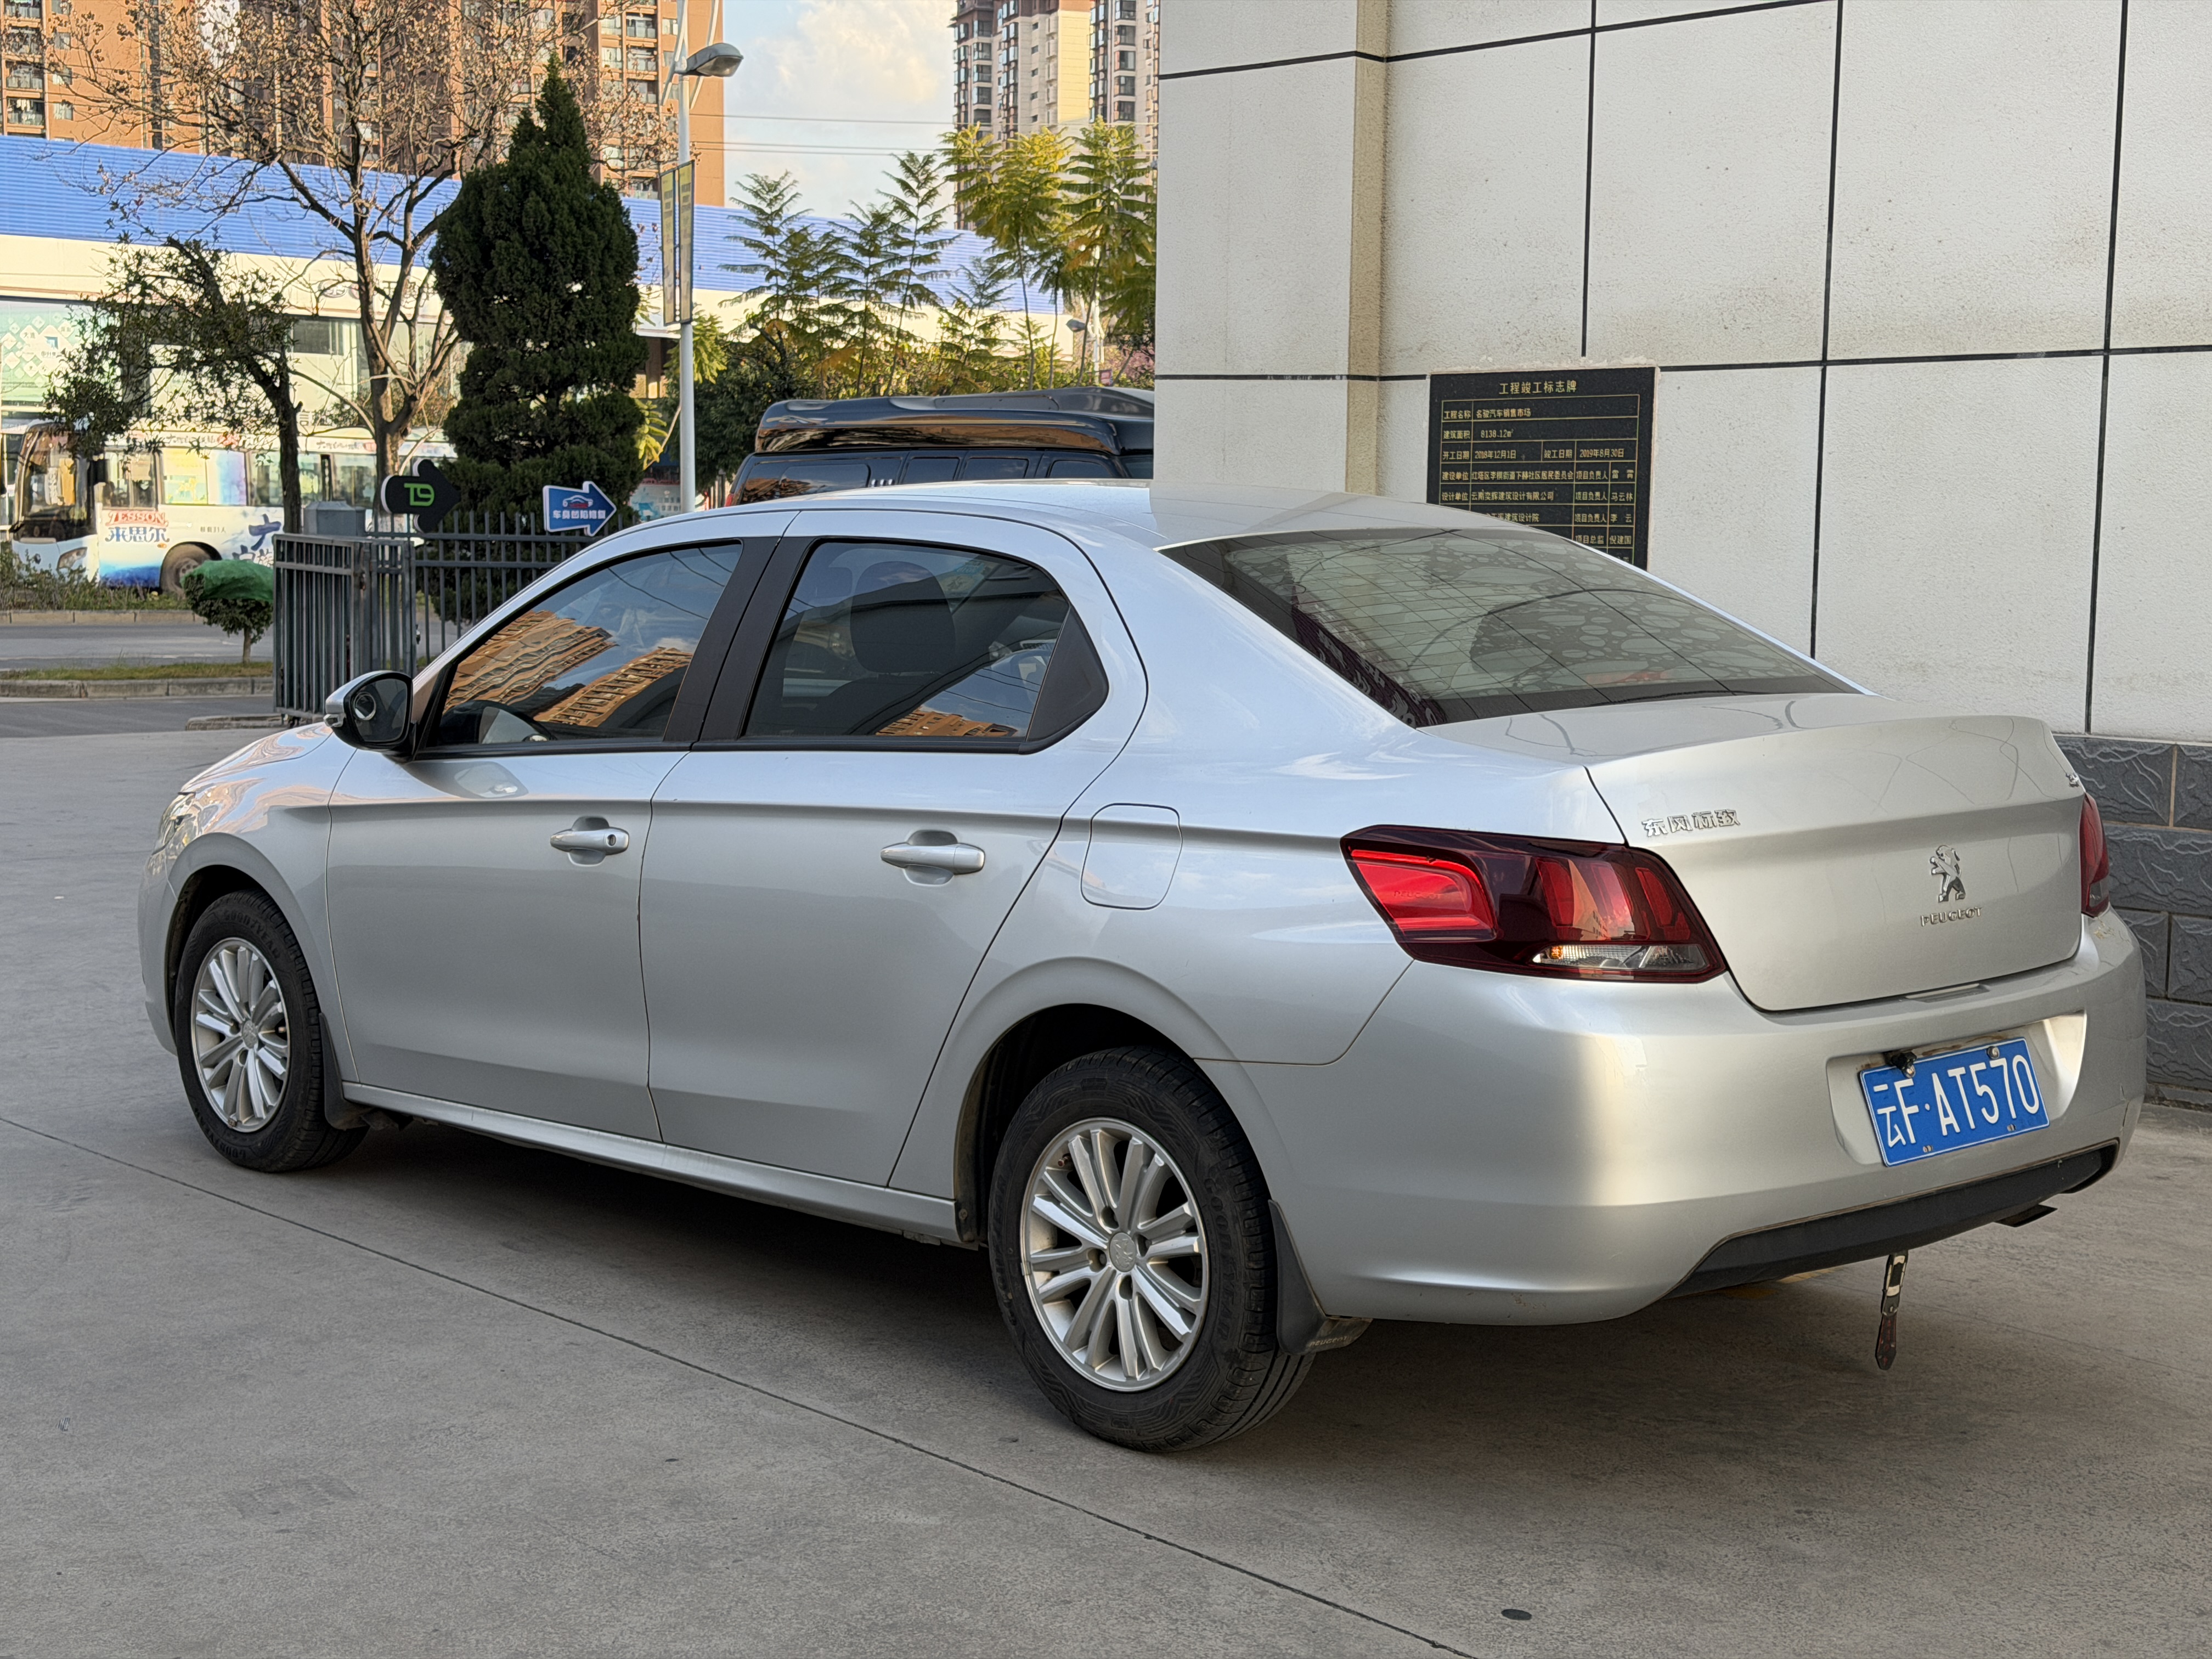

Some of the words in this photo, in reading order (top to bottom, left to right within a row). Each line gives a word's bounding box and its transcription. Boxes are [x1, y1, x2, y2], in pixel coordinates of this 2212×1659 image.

[1499, 380, 1577, 394] 工程竣工标志牌
[1443, 410, 1471, 419] 工程名称
[1443, 430, 1470, 439] 建筑面积
[1442, 450, 1470, 460] 开工日期
[1474, 450, 1516, 459] 2018年12月1日
[1544, 449, 1573, 459] 竣工日期
[1579, 448, 1624, 458] 2019年8月30日
[1442, 471, 1469, 481] 建设单位
[1576, 470, 1608, 480] 项目负责人
[1442, 492, 1468, 501] 设计单位
[1575, 492, 1607, 501] 项目负责人
[1611, 492, 1633, 501] 马云林
[1575, 513, 1607, 523] 项目负责人
[1576, 535, 1604, 545] 项目总监
[1641, 809, 1741, 837] 东风标致
[1920, 906, 1983, 927] PEUGEOT
